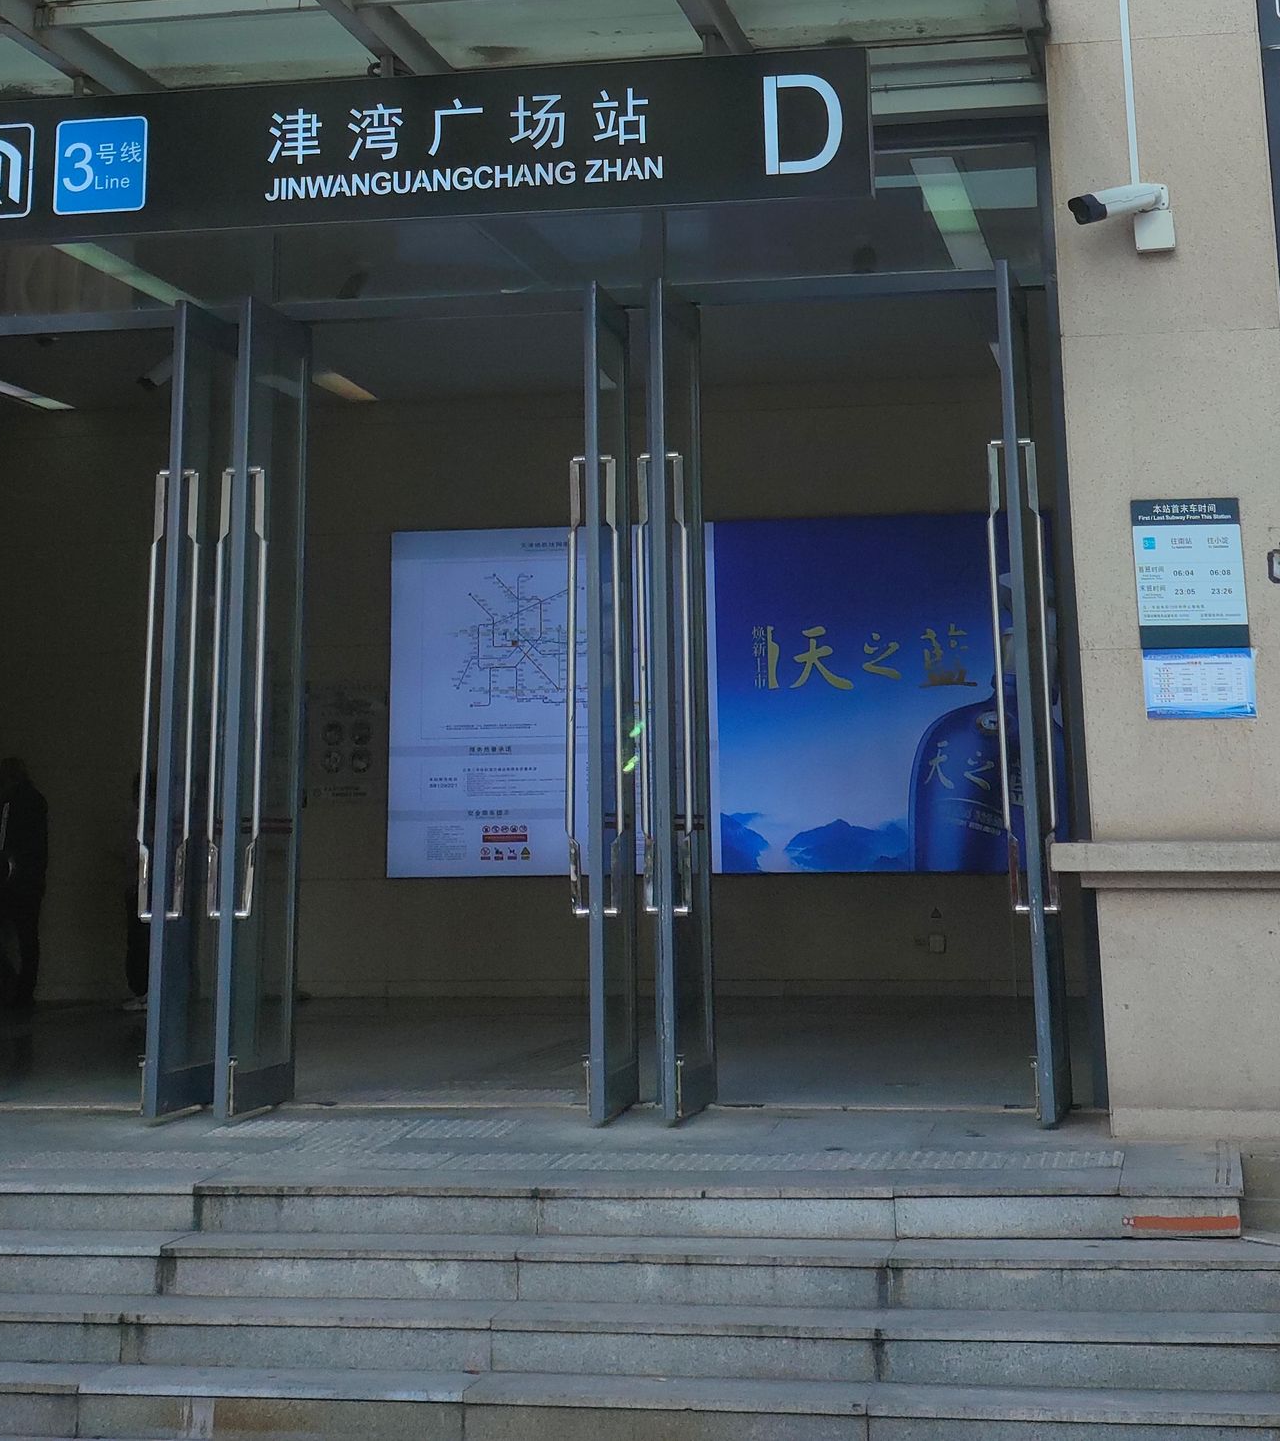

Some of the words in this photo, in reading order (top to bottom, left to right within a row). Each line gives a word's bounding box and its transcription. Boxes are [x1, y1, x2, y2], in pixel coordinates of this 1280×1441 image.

[267, 87, 651, 165] 津湾广场站
[763, 74, 843, 176] D
[94, 175, 131, 190] Line
[264, 161, 577, 203] JINWANGUANGCHANG
[584, 155, 664, 184] ZHAN
[1152, 503, 1217, 514] 本站首末车时间
